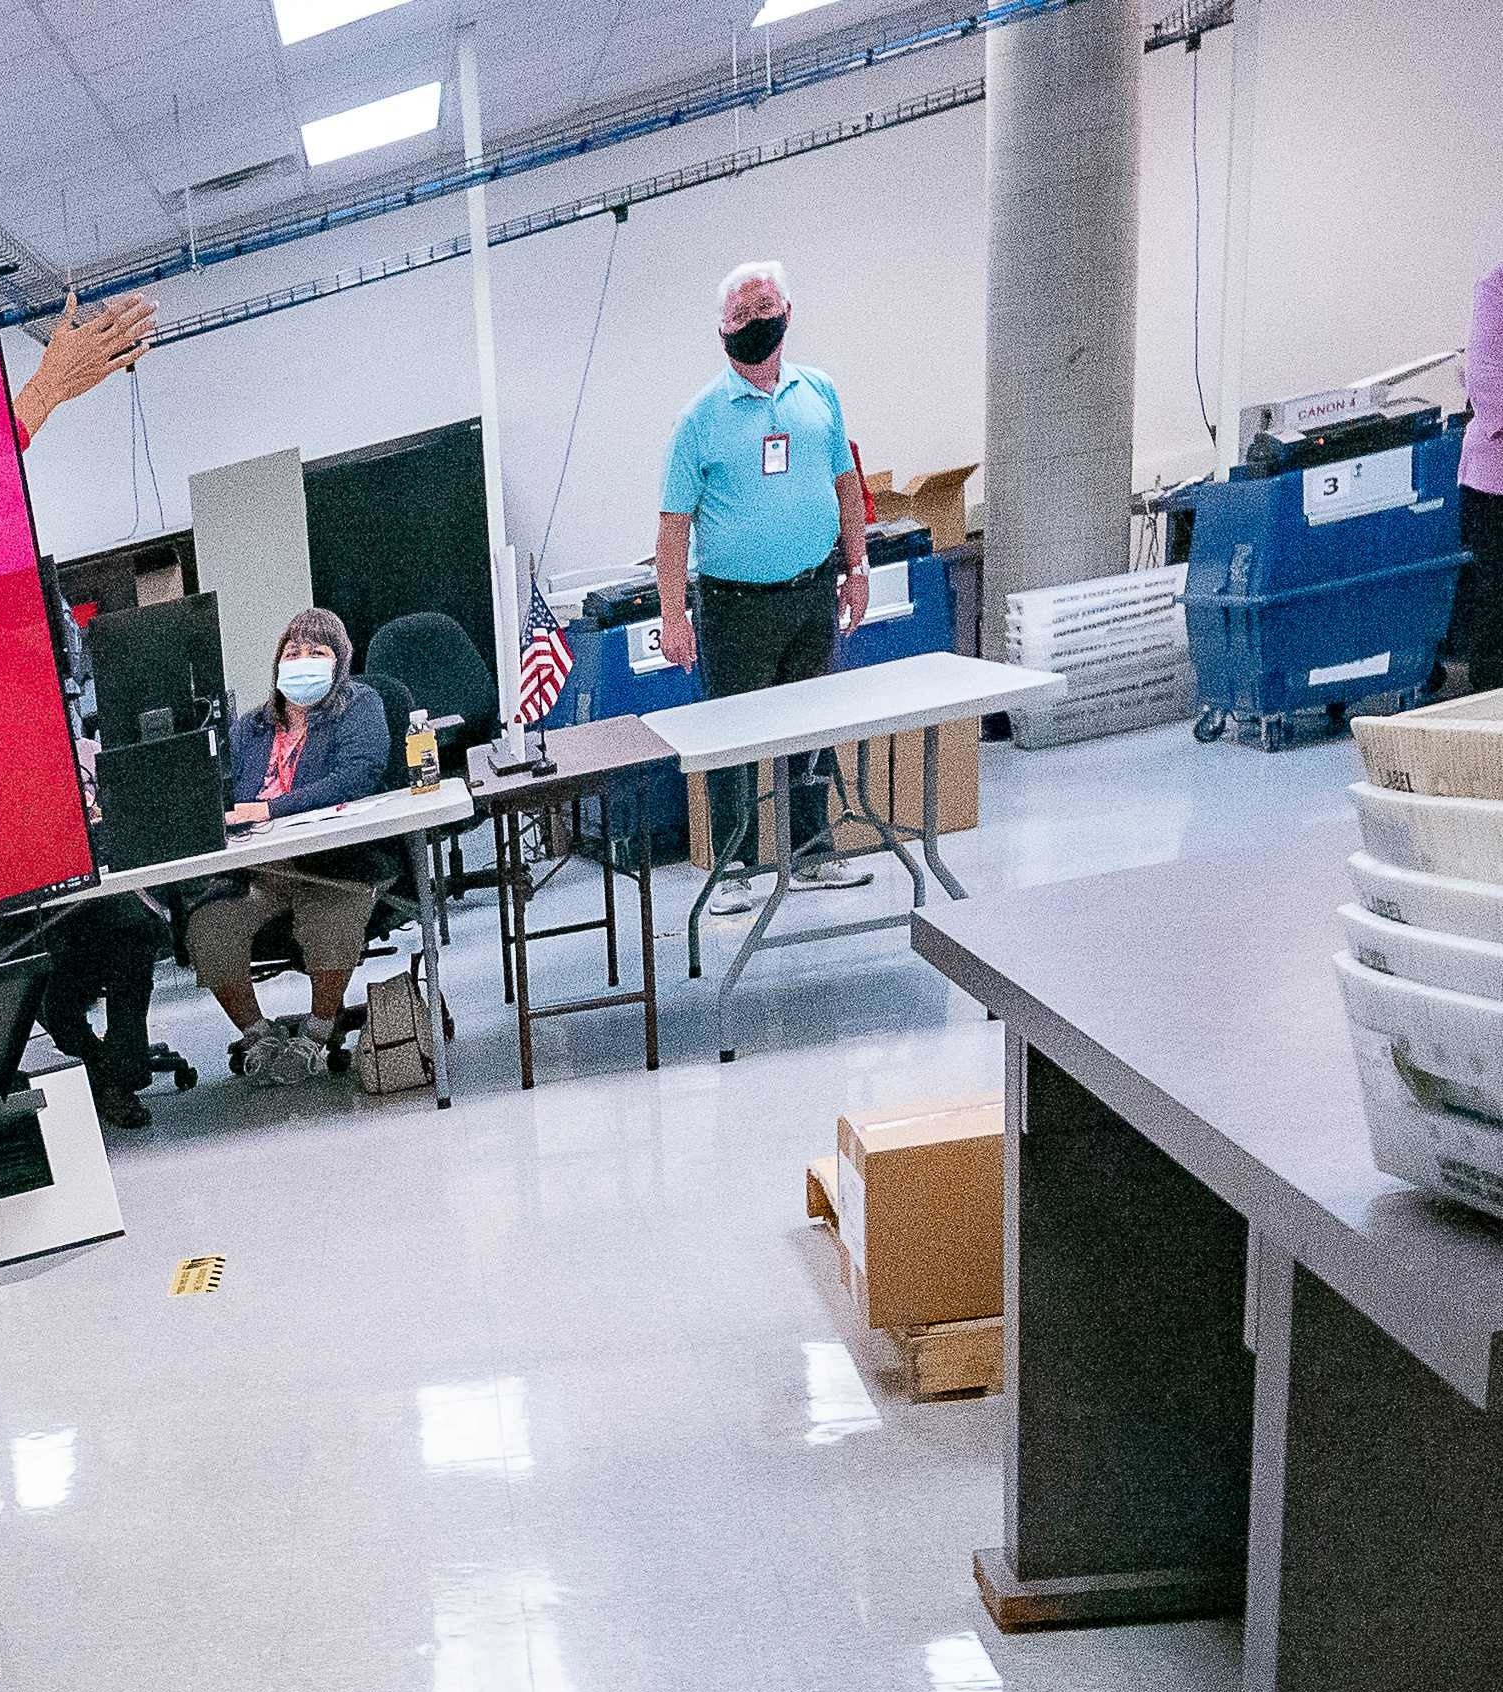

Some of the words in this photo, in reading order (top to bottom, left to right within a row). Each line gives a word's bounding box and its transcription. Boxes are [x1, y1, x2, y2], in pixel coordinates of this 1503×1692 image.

[1298, 400, 1346, 421] CANON
[1322, 476, 1340, 497] 3
[647, 627, 662, 652] 3
